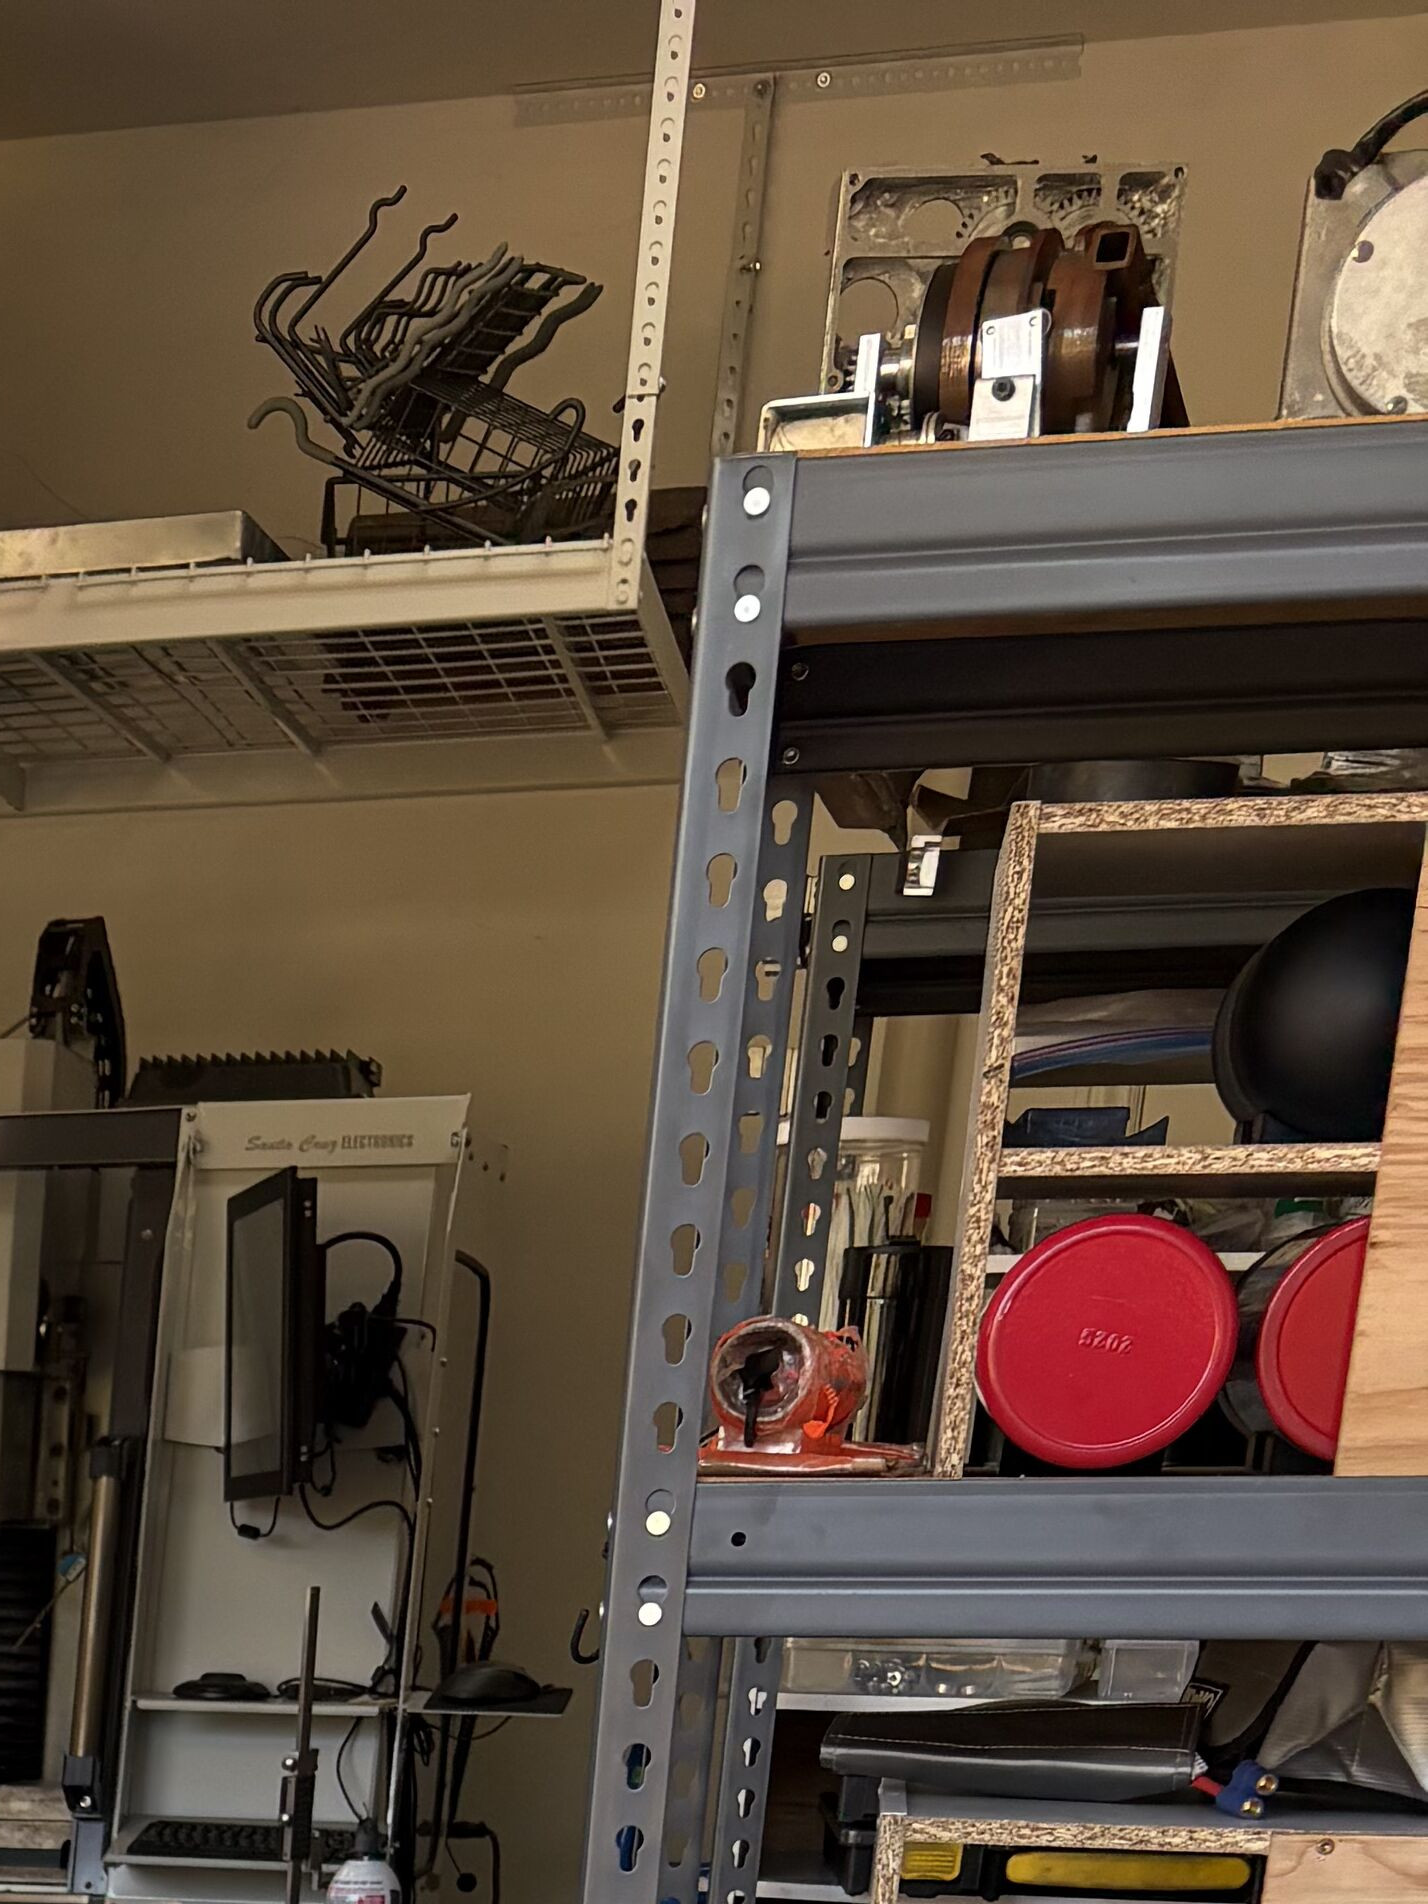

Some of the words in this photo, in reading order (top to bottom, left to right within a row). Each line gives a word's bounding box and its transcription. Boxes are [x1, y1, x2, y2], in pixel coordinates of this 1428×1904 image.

[245, 1135, 293, 1151] Santa
[298, 1134, 338, 1154] Cruz
[341, 1133, 414, 1150] ELECTRONICS
